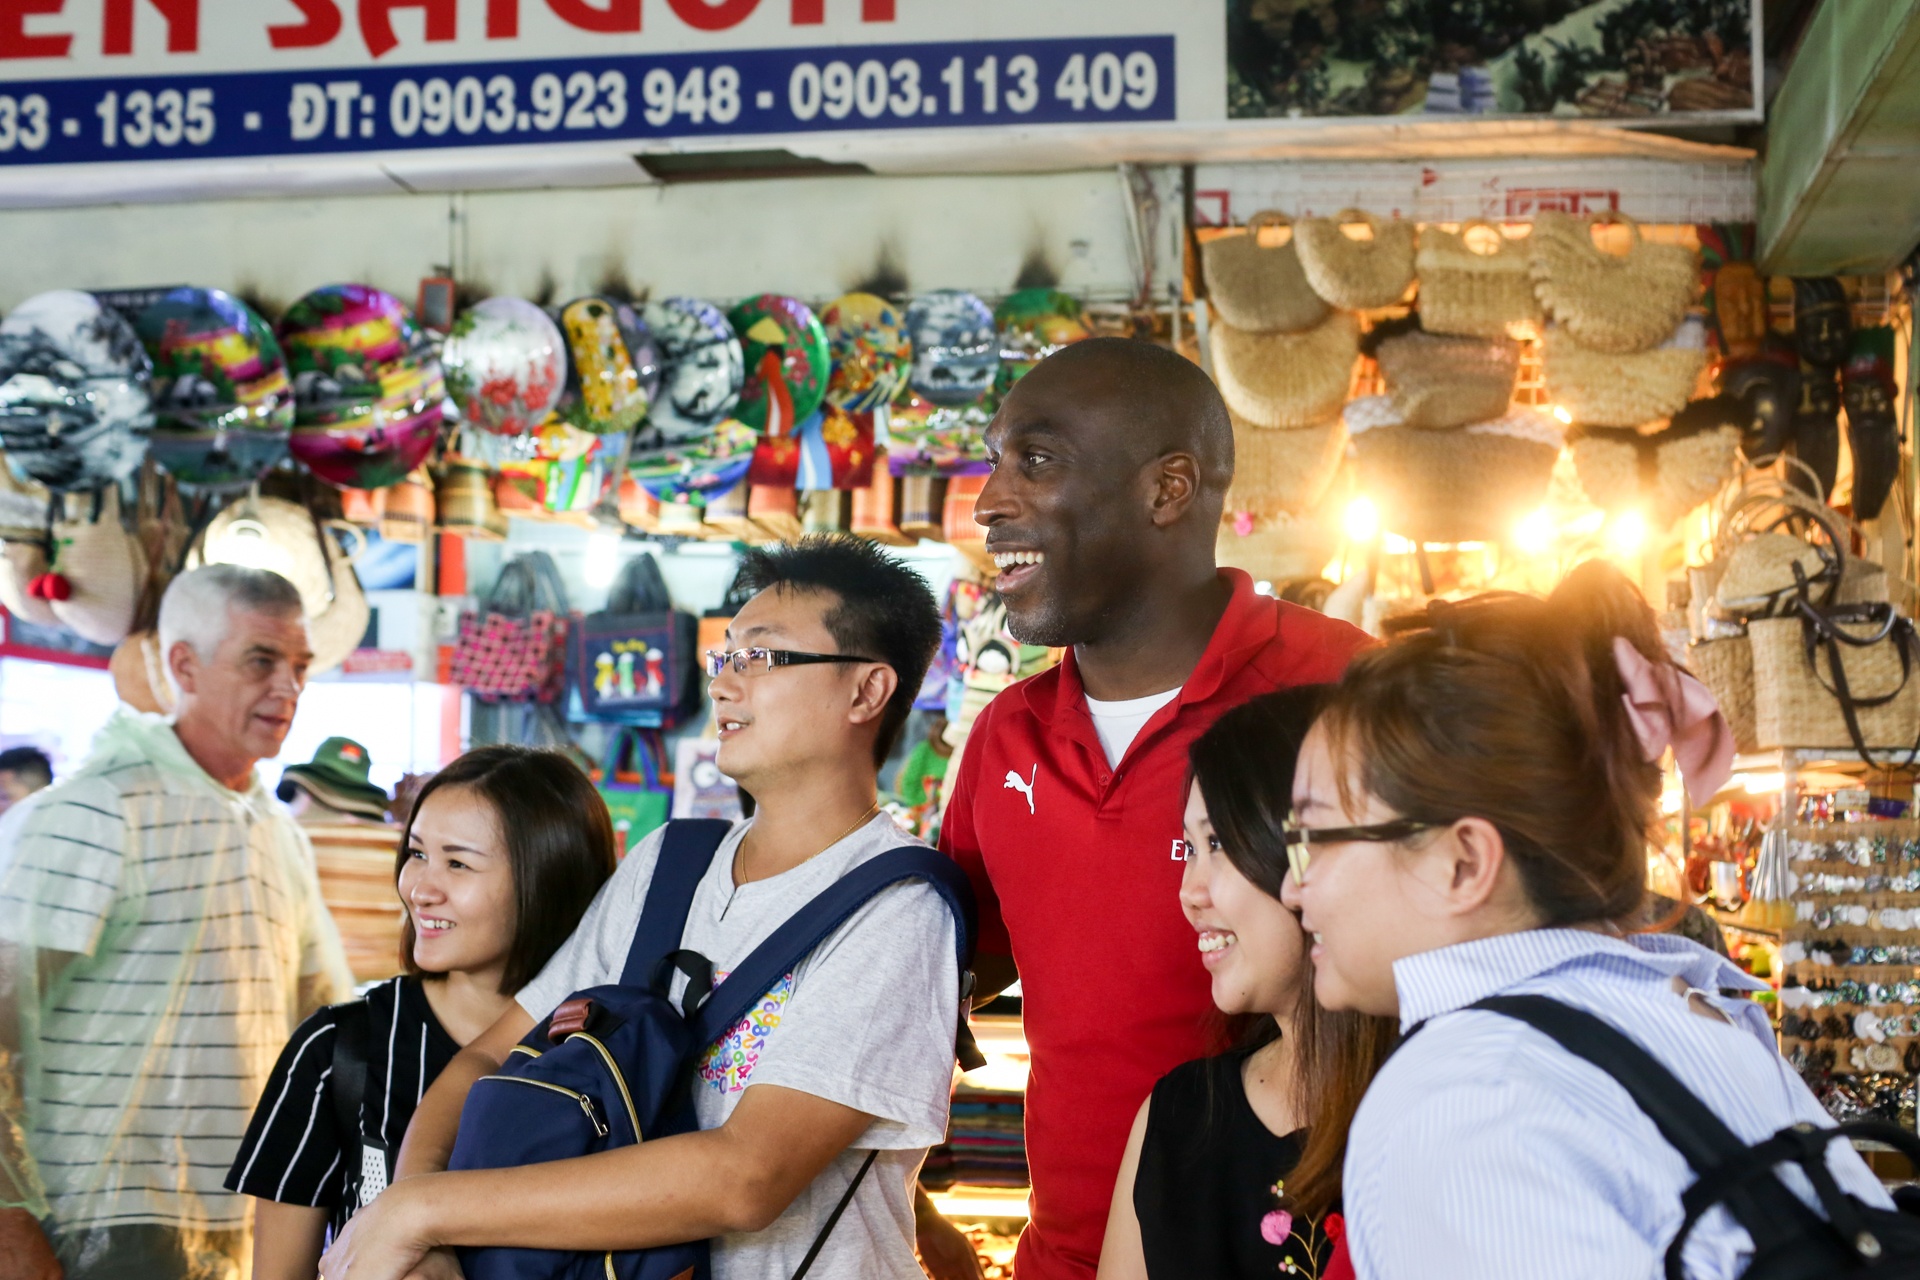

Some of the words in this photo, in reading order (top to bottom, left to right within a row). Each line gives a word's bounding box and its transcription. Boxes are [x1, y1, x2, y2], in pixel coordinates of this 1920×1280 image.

[96, 88, 215, 147] 1335
[390, 71, 627, 136] 0903.923
[643, 66, 740, 125] 948
[789, 55, 1039, 120] 0903.113
[1055, 51, 1158, 111] 409
